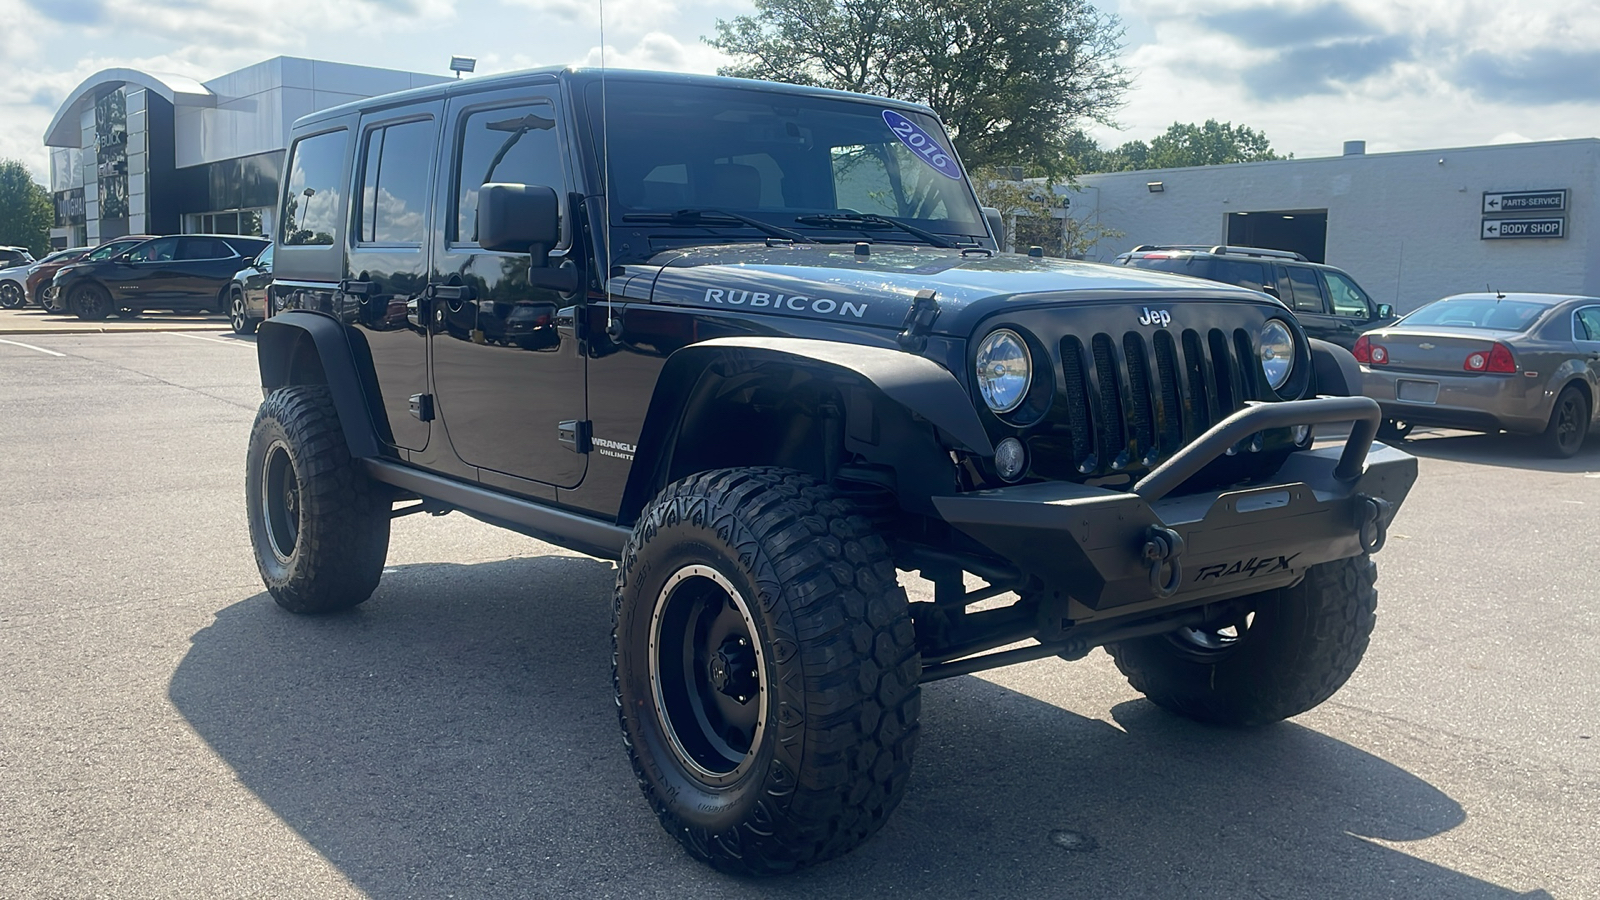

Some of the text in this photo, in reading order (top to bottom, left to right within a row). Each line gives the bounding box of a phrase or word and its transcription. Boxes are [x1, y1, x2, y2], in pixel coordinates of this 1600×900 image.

[101, 131, 121, 148] BUICK
[893, 121, 951, 168] 2016
[1501, 223, 1559, 234] BODY SHOP
[704, 288, 868, 318] RUBICON
[1140, 306, 1171, 328] Jep
